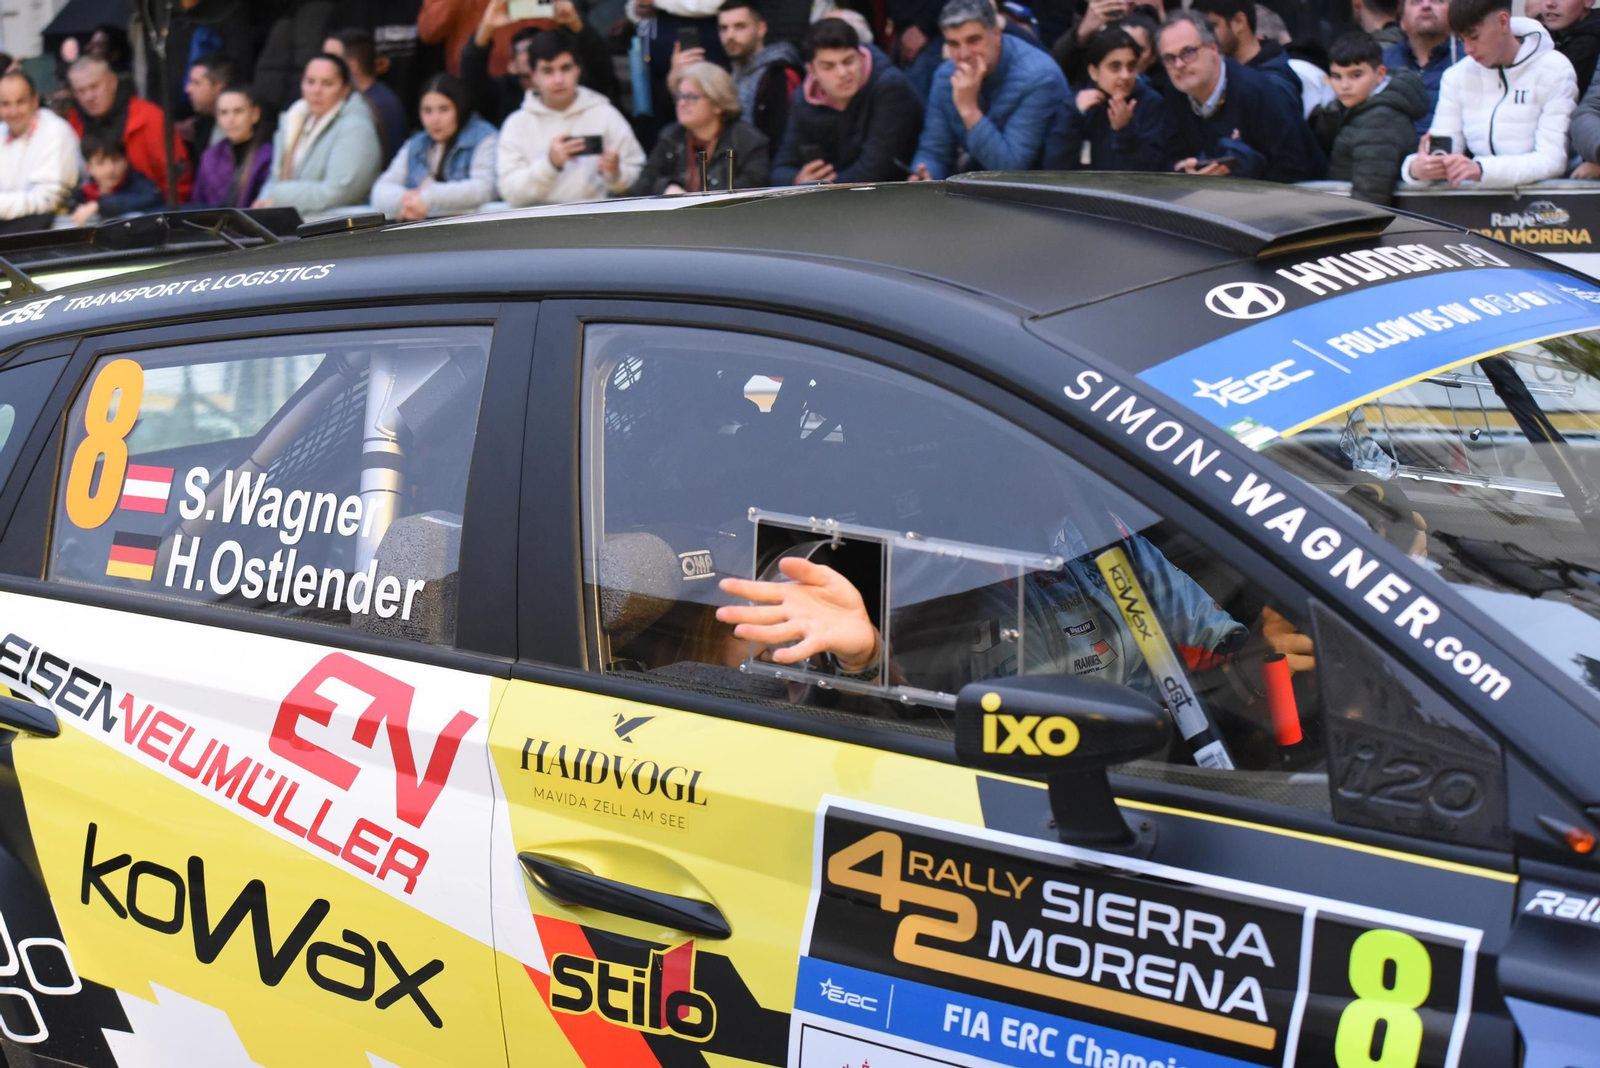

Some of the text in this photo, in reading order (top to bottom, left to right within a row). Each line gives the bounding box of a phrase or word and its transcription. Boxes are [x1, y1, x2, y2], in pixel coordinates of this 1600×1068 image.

[1490, 212, 1536, 231] Rallye
[1510, 228, 1592, 245] MORENA
[63, 279, 196, 311] TRANSPORT
[190, 277, 213, 293] &
[211, 263, 336, 290] LOGISTICS
[1275, 243, 1462, 296] HYUNDAI
[1326, 315, 1426, 359] FOLLOW
[1408, 307, 1454, 332] US
[1437, 301, 1482, 324] ON
[65, 358, 145, 530] 8
[178, 466, 384, 546] S.Wagner
[1063, 370, 1513, 701] SIMON-WAGNER.com
[164, 534, 426, 621] H.Ostlender
[681, 554, 714, 576] OMP
[980, 692, 1081, 757] ixo
[520, 737, 708, 807] HAIDVOGL
[533, 786, 686, 830] MAVIDA ZELL AM SEE
[908, 850, 1033, 900] RALLY
[1041, 880, 1276, 969] SIERRA
[987, 919, 1269, 1024] MORENA
[1334, 928, 1432, 1068] 8
[943, 1002, 991, 1043] FIA
[1000, 1016, 1060, 1058] ERC
